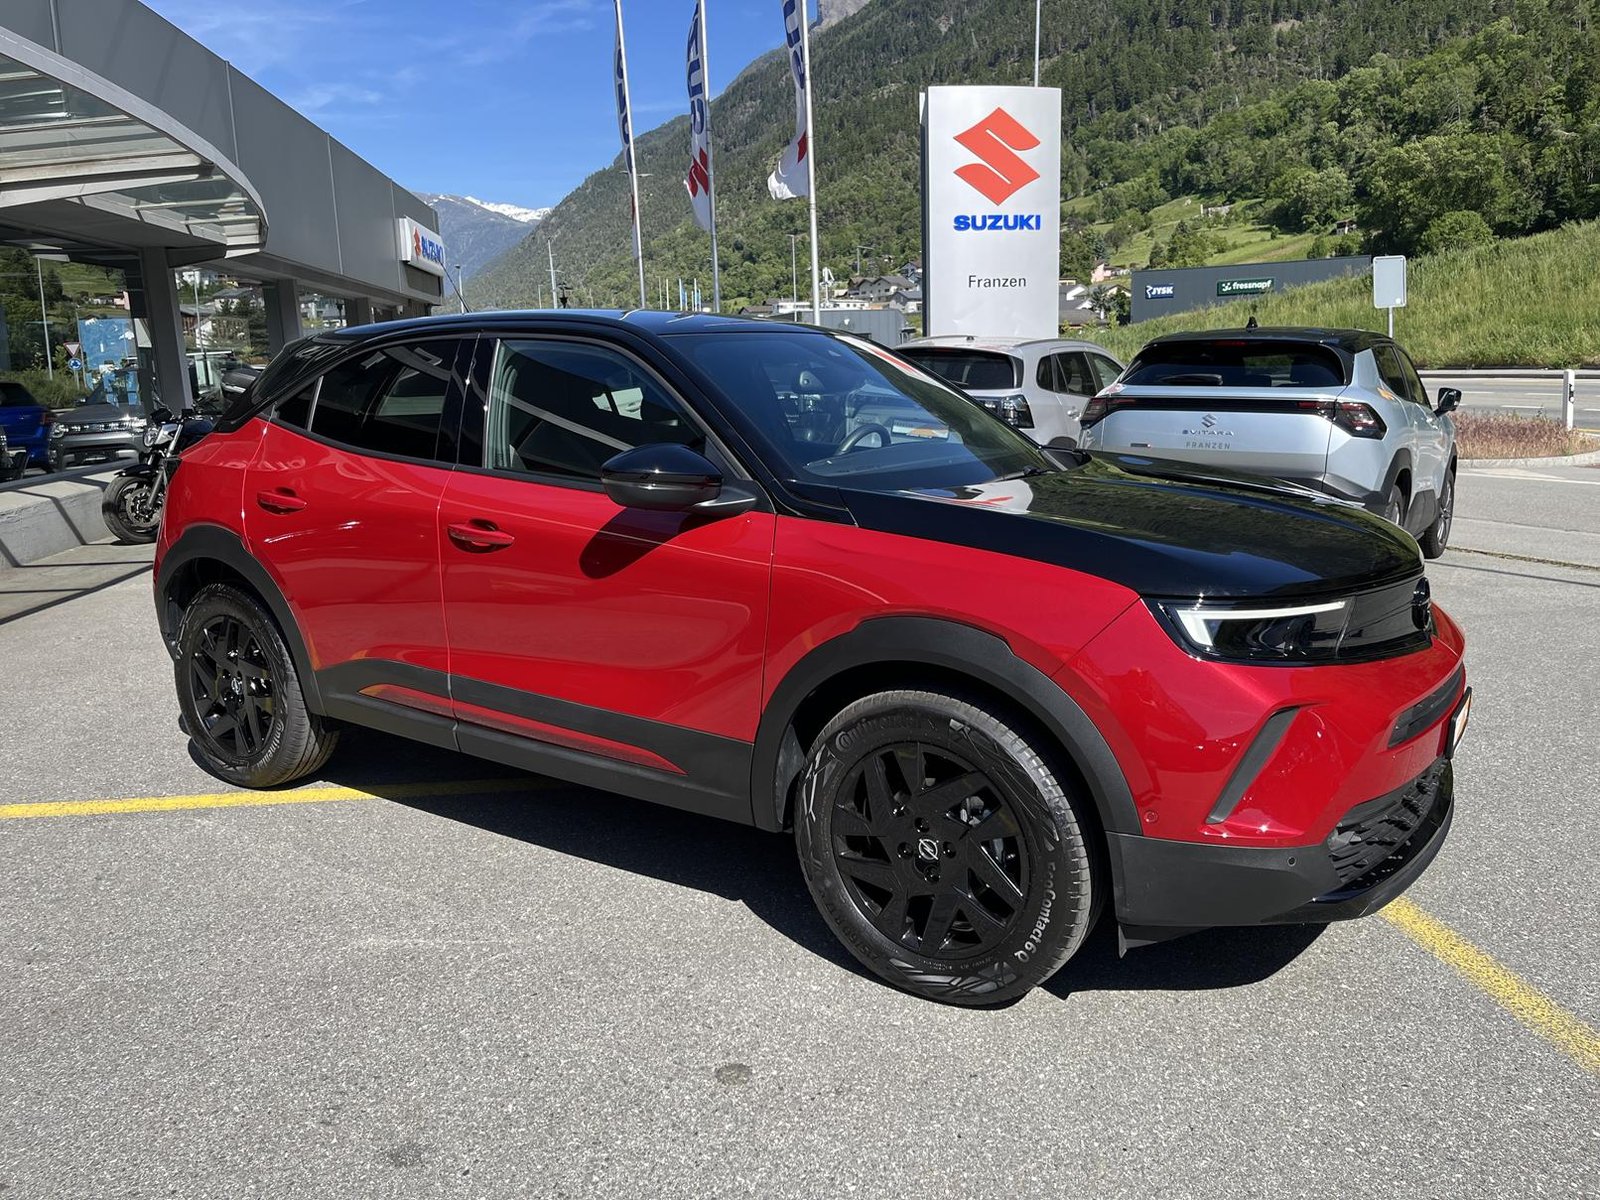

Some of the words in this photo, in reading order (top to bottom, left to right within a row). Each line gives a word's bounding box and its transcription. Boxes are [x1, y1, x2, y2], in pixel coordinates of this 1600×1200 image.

[953, 214, 1041, 231] SUZUKI
[968, 274, 1027, 288] Franzen
[1232, 279, 1272, 290] fressnapf
[1151, 286, 1173, 295] JYSK
[1185, 441, 1231, 450] FRANZEN
[1024, 940, 1037, 954] 6
[1014, 949, 1030, 963] Q
